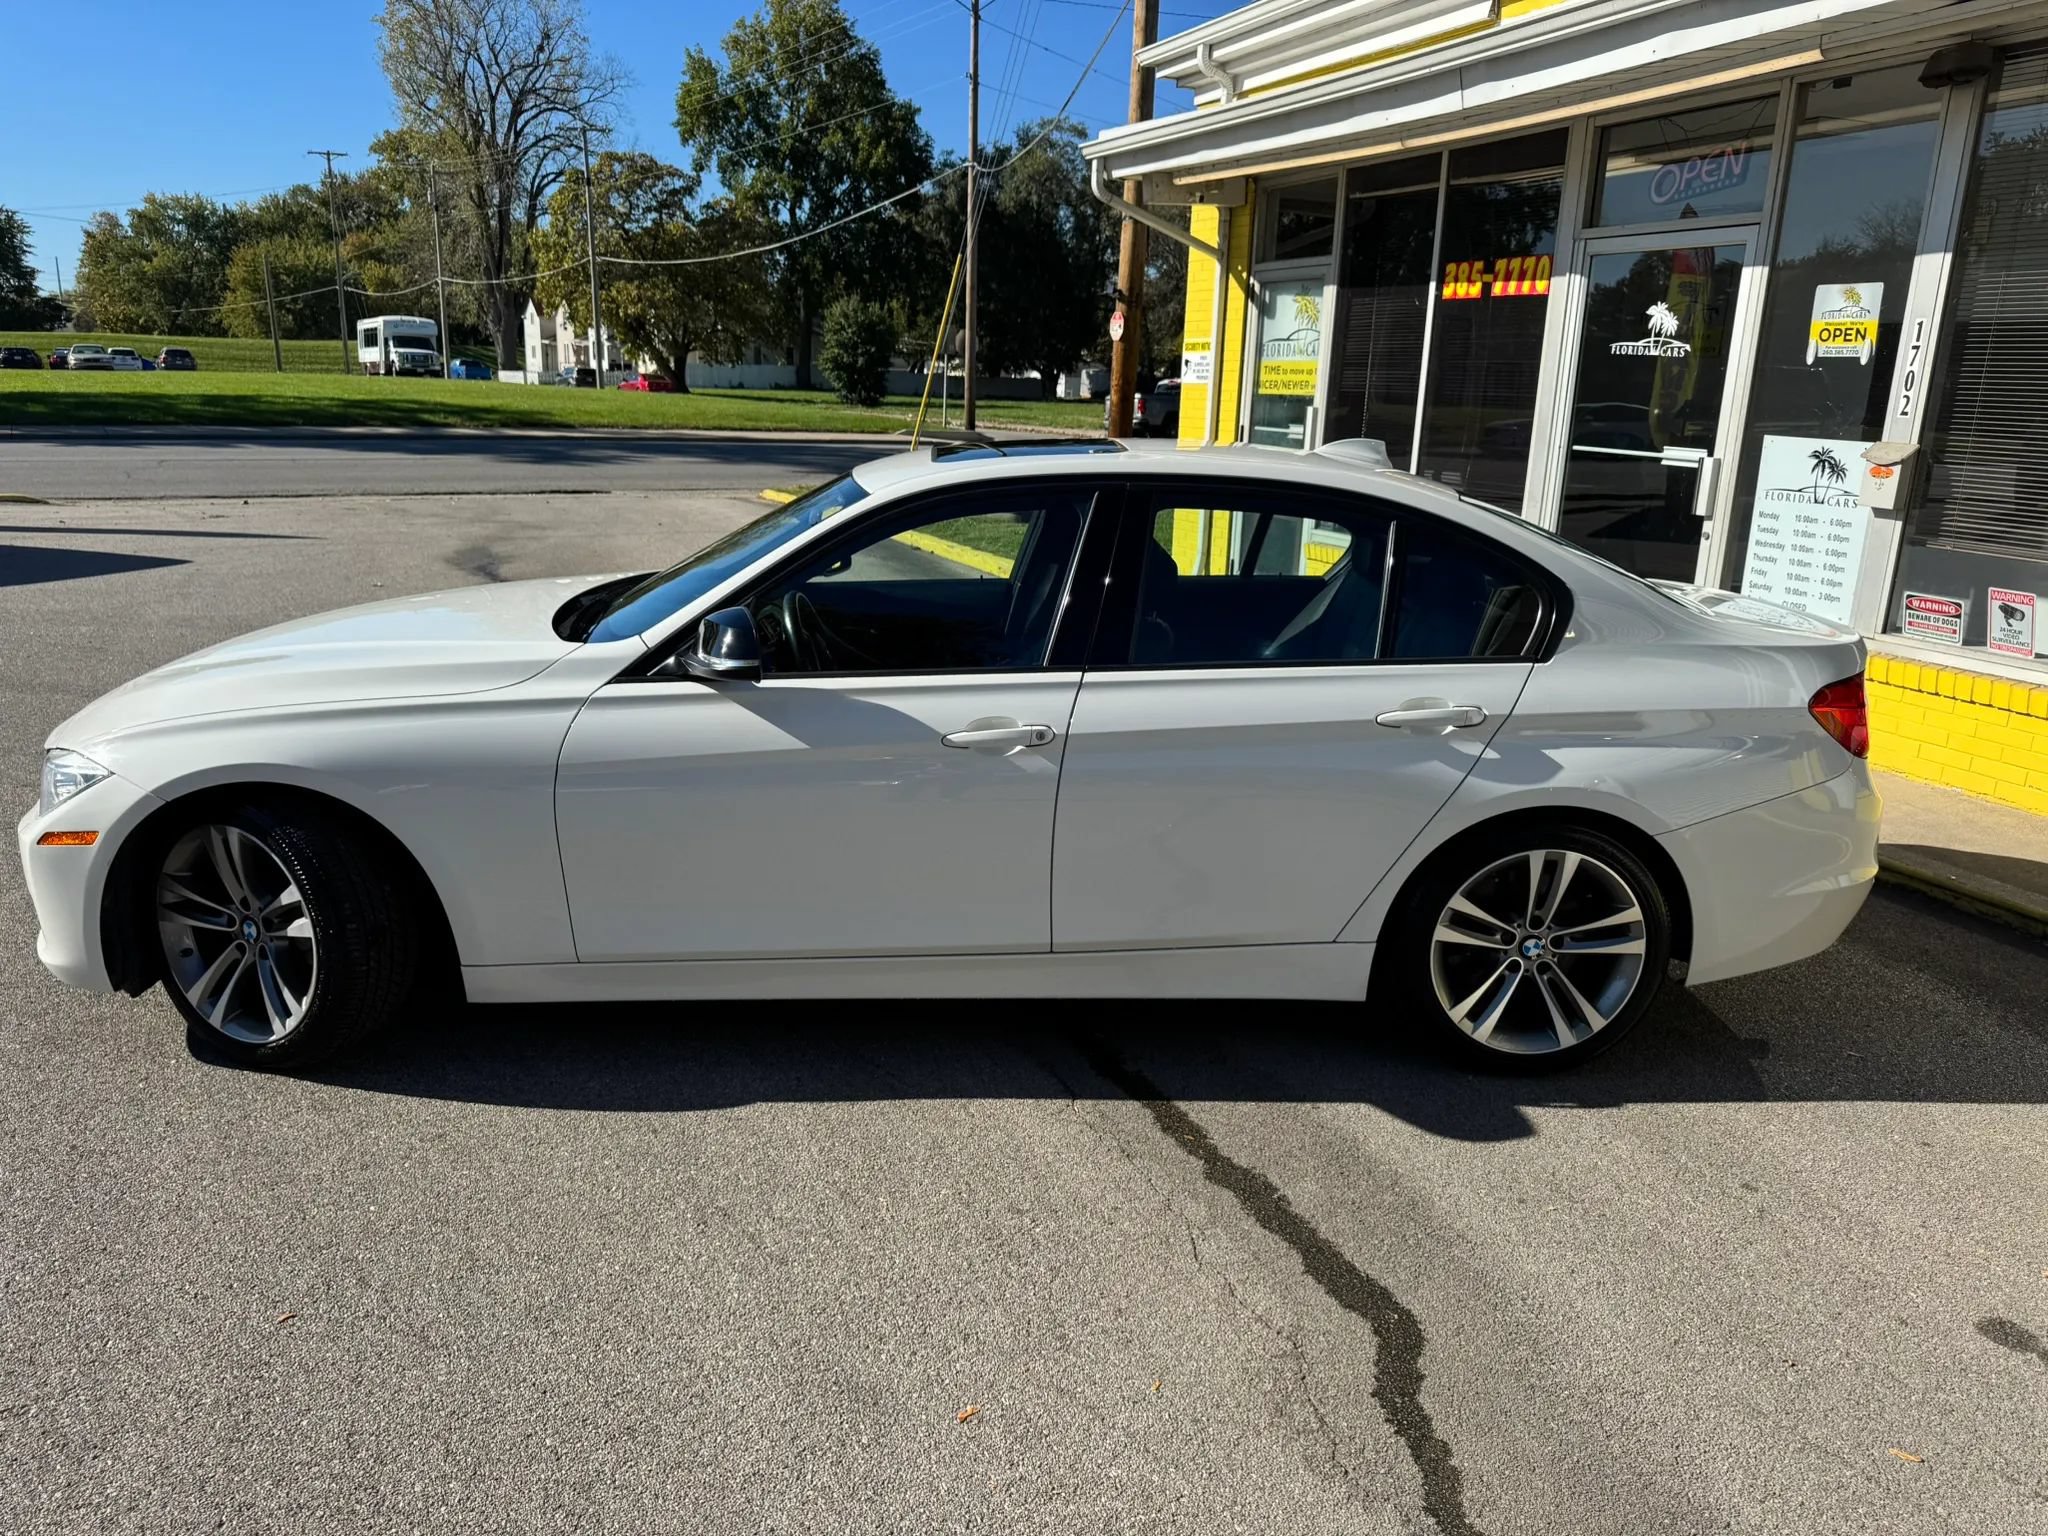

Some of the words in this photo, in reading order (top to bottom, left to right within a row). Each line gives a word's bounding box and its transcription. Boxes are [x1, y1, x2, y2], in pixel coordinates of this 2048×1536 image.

[1650, 143, 1747, 203] OPEN
[1442, 255, 1551, 298] 385-7770
[1852, 311, 1867, 319] CARS
[1819, 327, 1867, 342] OPEN
[1262, 343, 1296, 358] FLORIDA
[1611, 345, 1649, 355] FLORIDA
[1660, 346, 1685, 357] CARS
[1264, 365, 1281, 375] TIME
[1306, 368, 1313, 376] up
[1899, 320, 1924, 416] 1702
[1765, 490, 1812, 505] FLORIDA
[1826, 496, 1858, 508] CARS
[1759, 511, 1780, 521] Monday
[1757, 525, 1779, 536] Tuesday
[1755, 539, 1785, 551] Wednesday
[1753, 553, 1777, 565] Thursday
[1751, 567, 1767, 578] Friday
[1749, 580, 1772, 592] Saturday
[1992, 591, 2034, 605] WARNING
[1911, 599, 1956, 613] WARNING
[1908, 612, 1932, 623] BEWARE
[1942, 618, 1958, 627] DOGS
[2007, 628, 2022, 636] HOUR
[1992, 636, 2030, 648] SURVEILLANCE
